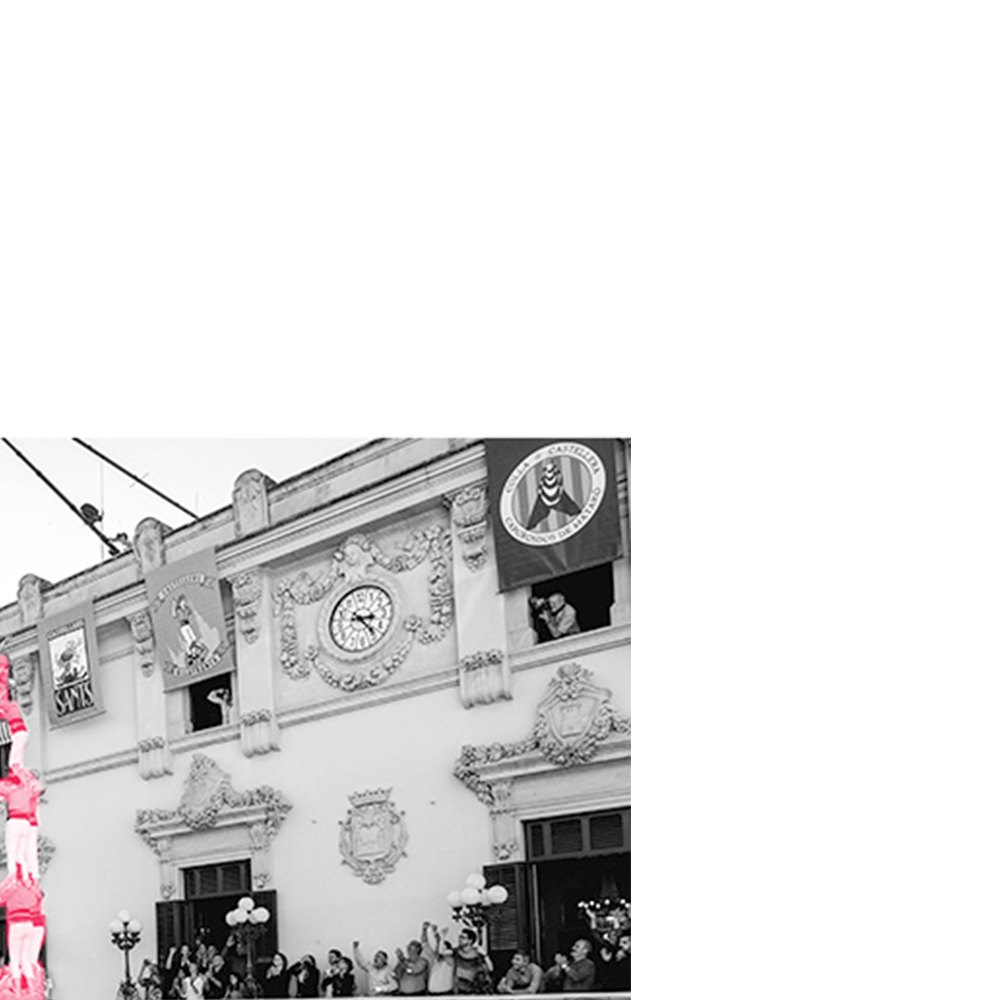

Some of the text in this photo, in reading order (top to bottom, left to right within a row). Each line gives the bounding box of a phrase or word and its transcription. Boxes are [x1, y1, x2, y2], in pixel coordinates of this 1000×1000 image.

[506, 445, 601, 493] COLLA CASTELLERA
[54, 682, 95, 718] SANTS
